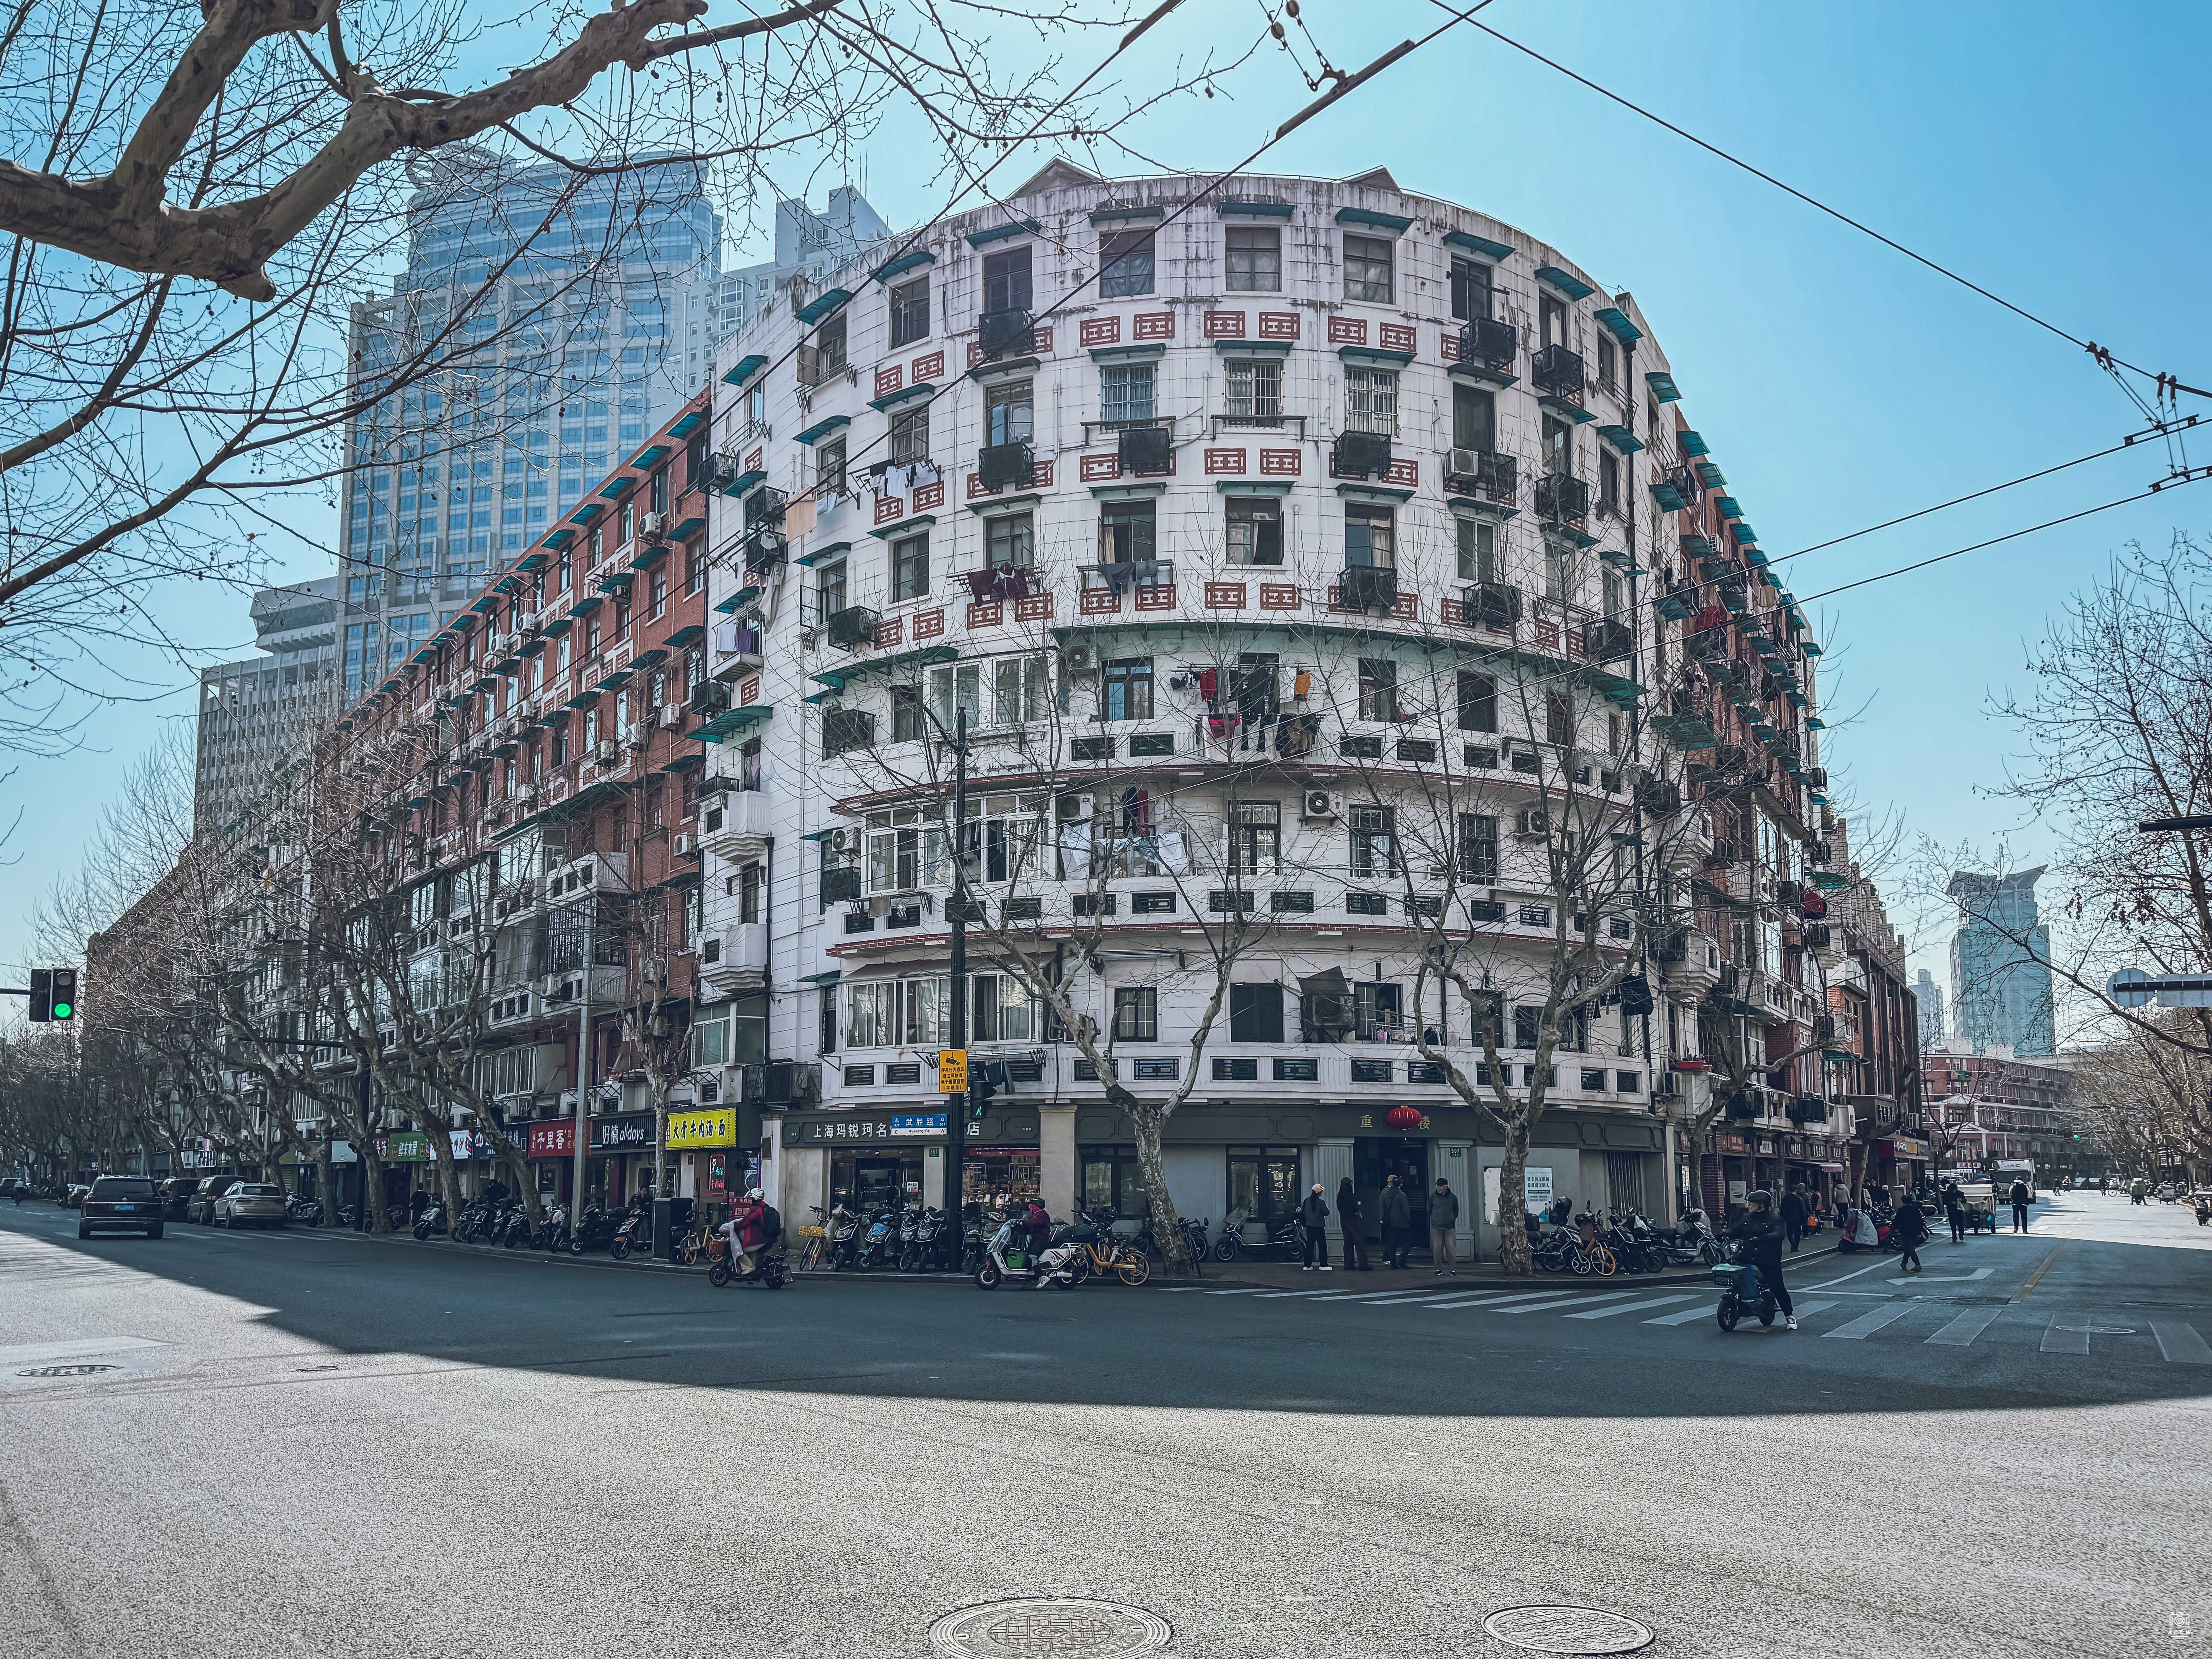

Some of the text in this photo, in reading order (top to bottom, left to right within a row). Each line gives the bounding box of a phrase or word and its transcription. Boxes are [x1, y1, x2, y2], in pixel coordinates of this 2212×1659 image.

[905, 1118, 933, 1126] 武胜路
[537, 1130, 564, 1150] 千里香
[603, 1125, 618, 1144] 好德
[620, 1122, 644, 1144] alldays
[398, 1141, 417, 1157] 鲜丰水果
